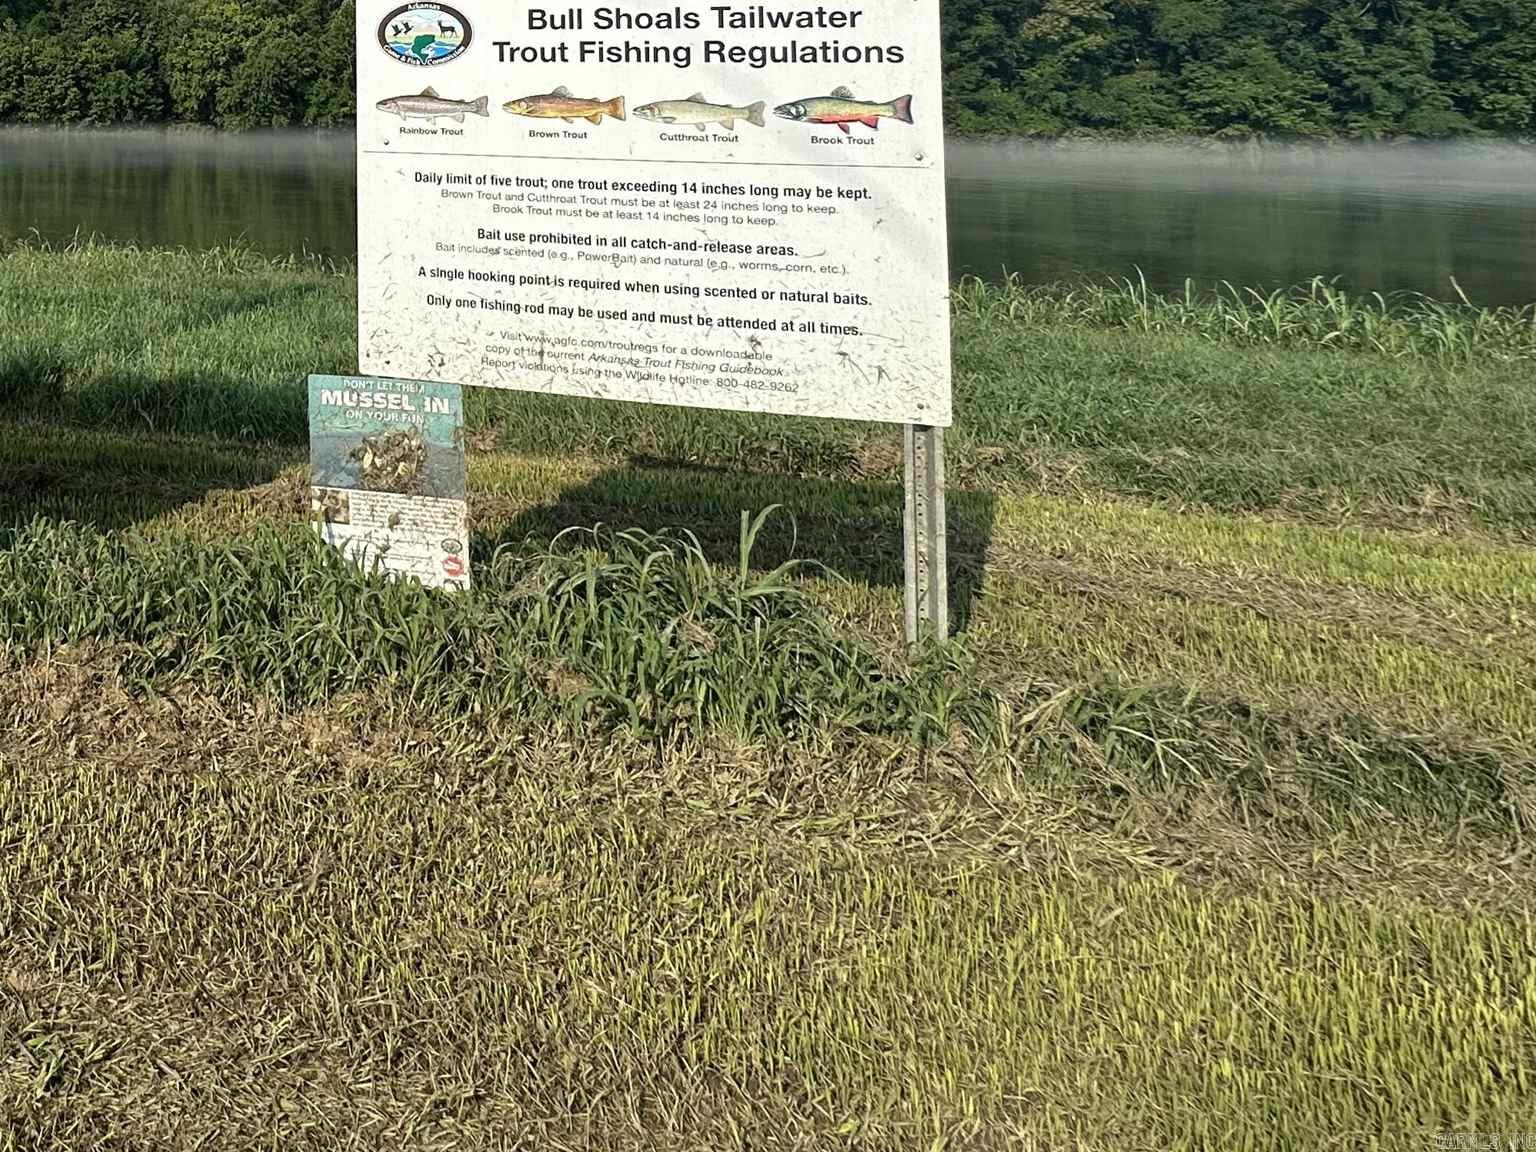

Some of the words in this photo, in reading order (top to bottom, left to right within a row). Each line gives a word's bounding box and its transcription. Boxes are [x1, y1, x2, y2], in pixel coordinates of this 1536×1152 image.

[528, 7, 583, 31] Bull
[593, 6, 701, 31] Shoals
[710, 5, 863, 30] Tailwater
[491, 41, 570, 64] Trout
[579, 40, 692, 69] Fishing
[703, 39, 905, 70] Regulations
[399, 126, 439, 136] Rainbow
[439, 127, 464, 136] Trout
[528, 129, 561, 139] Brown
[562, 130, 588, 140] Trout
[659, 132, 710, 143] Cutthroat
[711, 133, 740, 143] Trout
[810, 135, 845, 145] Brook
[846, 136, 876, 146] Trout
[414, 171, 444, 186] Daily
[446, 173, 473, 185] limit
[475, 174, 488, 186] of
[490, 174, 513, 187] five
[515, 175, 549, 190] trout;
[551, 179, 575, 190] one
[577, 178, 609, 191] trout
[611, 180, 678, 197] exceeding
[681, 181, 698, 195] 14
[701, 182, 747, 196] inches
[749, 184, 779, 200] long
[783, 187, 812, 201] may
[815, 185, 834, 199] be
[837, 186, 873, 203] kept.
[440, 188, 474, 200] Brown
[476, 190, 502, 201] Trout
[504, 192, 525, 202] and
[526, 192, 578, 205] Cutthroat
[579, 194, 608, 206] Trout
[610, 197, 639, 208] must
[641, 197, 657, 208] be
[658, 199, 671, 209] at
[673, 199, 701, 211] least
[703, 200, 718, 211] 24
[721, 200, 760, 212] inches
[762, 202, 789, 215] long
[791, 203, 804, 214] to
[806, 203, 841, 216] keep.
[492, 203, 524, 215] Brook
[525, 205, 553, 217] Trout
[555, 208, 583, 218] must
[585, 208, 600, 219] be
[602, 210, 614, 220] at
[616, 209, 644, 221] least
[646, 211, 660, 221] 14
[663, 211, 701, 223] inches
[703, 213, 729, 226] long
[731, 215, 745, 225] to
[746, 215, 779, 228] keep.
[435, 242, 456, 252] Bait
[503, 246, 545, 259] scented
[639, 255, 662, 266] and
[663, 257, 704, 268] natural
[477, 228, 502, 241] Bait
[504, 232, 526, 243] use
[529, 232, 592, 247] prohibited
[596, 234, 608, 247] in
[611, 236, 627, 249] all
[630, 238, 753, 255] catch-and-release
[756, 244, 799, 257] areas.
[417, 265, 427, 278] A
[429, 267, 465, 282] single
[468, 269, 516, 286] hooking
[519, 273, 552, 287] point
[553, 275, 565, 288] is
[568, 278, 621, 292] required
[624, 280, 660, 295] when
[664, 283, 700, 299] using
[704, 287, 758, 300] scented
[761, 290, 776, 301] or
[779, 290, 829, 304] natural
[833, 292, 873, 306] baits.
[426, 294, 452, 310] Only
[455, 298, 477, 309] one
[480, 298, 522, 316] fishing
[524, 303, 545, 315] rod
[548, 306, 575, 320] may
[578, 305, 594, 319] be
[597, 309, 628, 321] used
[631, 311, 656, 324] and
[659, 314, 694, 326] must
[697, 314, 714, 327] be
[717, 316, 777, 332] attended
[781, 320, 795, 333] at
[798, 321, 816, 334] all
[819, 322, 864, 337] times.
[499, 330, 522, 343] Visit
[661, 343, 678, 355] for
[680, 347, 688, 356] a
[690, 346, 773, 361] downloadable
[481, 356, 516, 371] Report
[604, 369, 624, 381] the
[716, 377, 799, 393] 800-482-9262
[321, 389, 416, 411] MUSSEL
[424, 396, 450, 414] IN
[345, 409, 363, 419] ON
